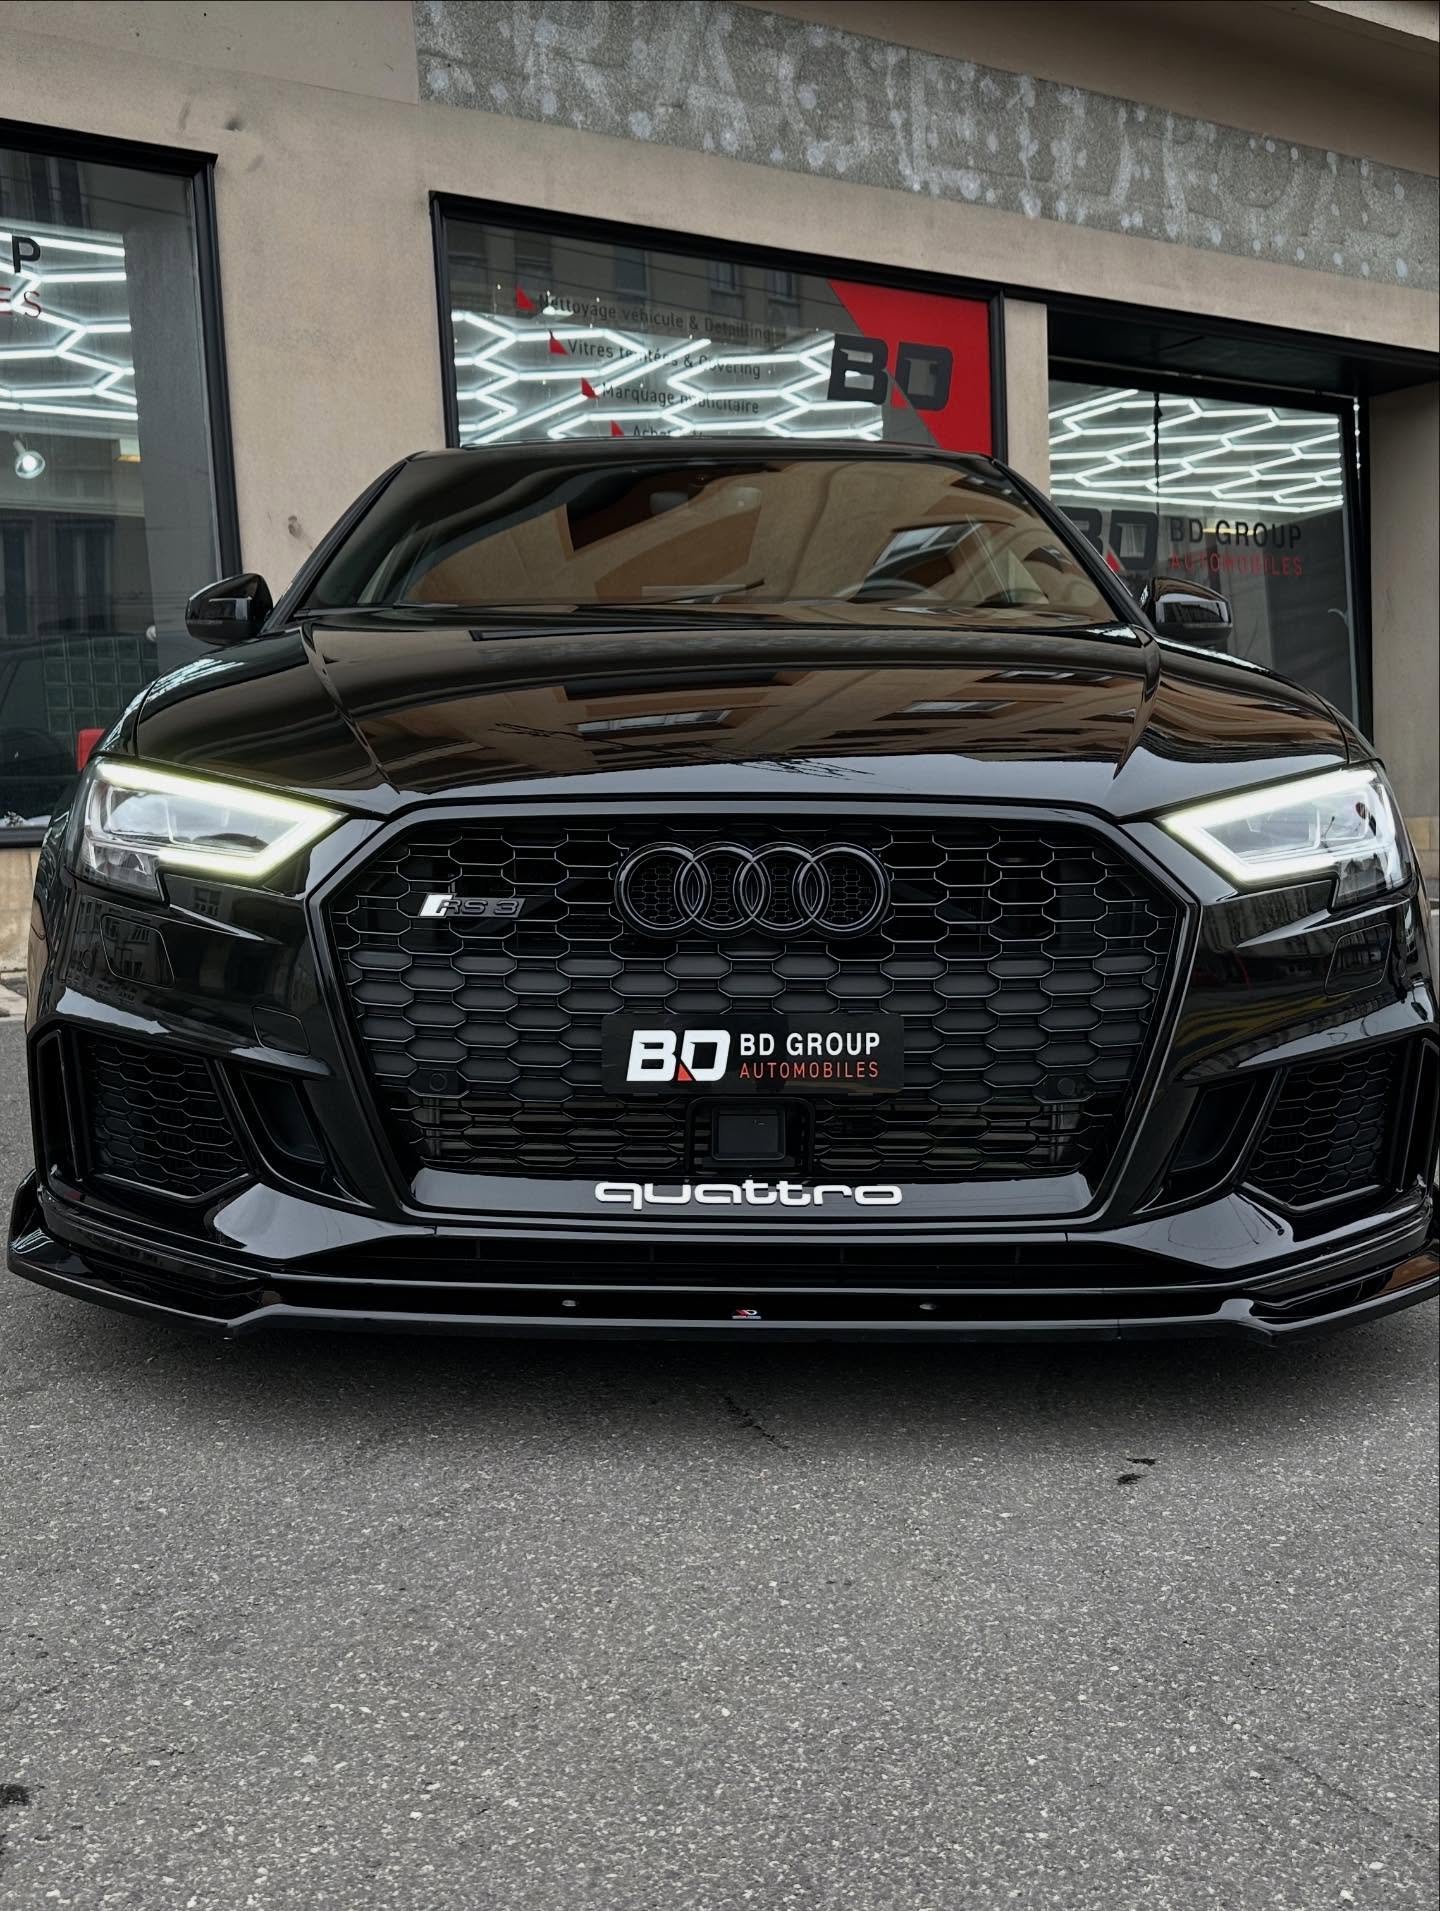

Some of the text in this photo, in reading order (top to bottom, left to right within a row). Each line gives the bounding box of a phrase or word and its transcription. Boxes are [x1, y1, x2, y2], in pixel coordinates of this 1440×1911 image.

[538, 292, 617, 320] Nettoyage
[688, 314, 699, 330] &
[567, 338, 614, 359] Vitres
[618, 346, 679, 367] tetés
[683, 353, 694, 369] &
[827, 333, 954, 412] BD
[602, 381, 760, 415] Marquage pblicitaire
[1169, 517, 1302, 549] BD GROUP
[1169, 552, 1304, 577] AUTOMOBILES
[626, 1029, 731, 1082] BD
[740, 1032, 880, 1056] BD GROUP
[739, 1061, 879, 1079] AUTOMOBILES
[595, 1179, 902, 1211] quattro
